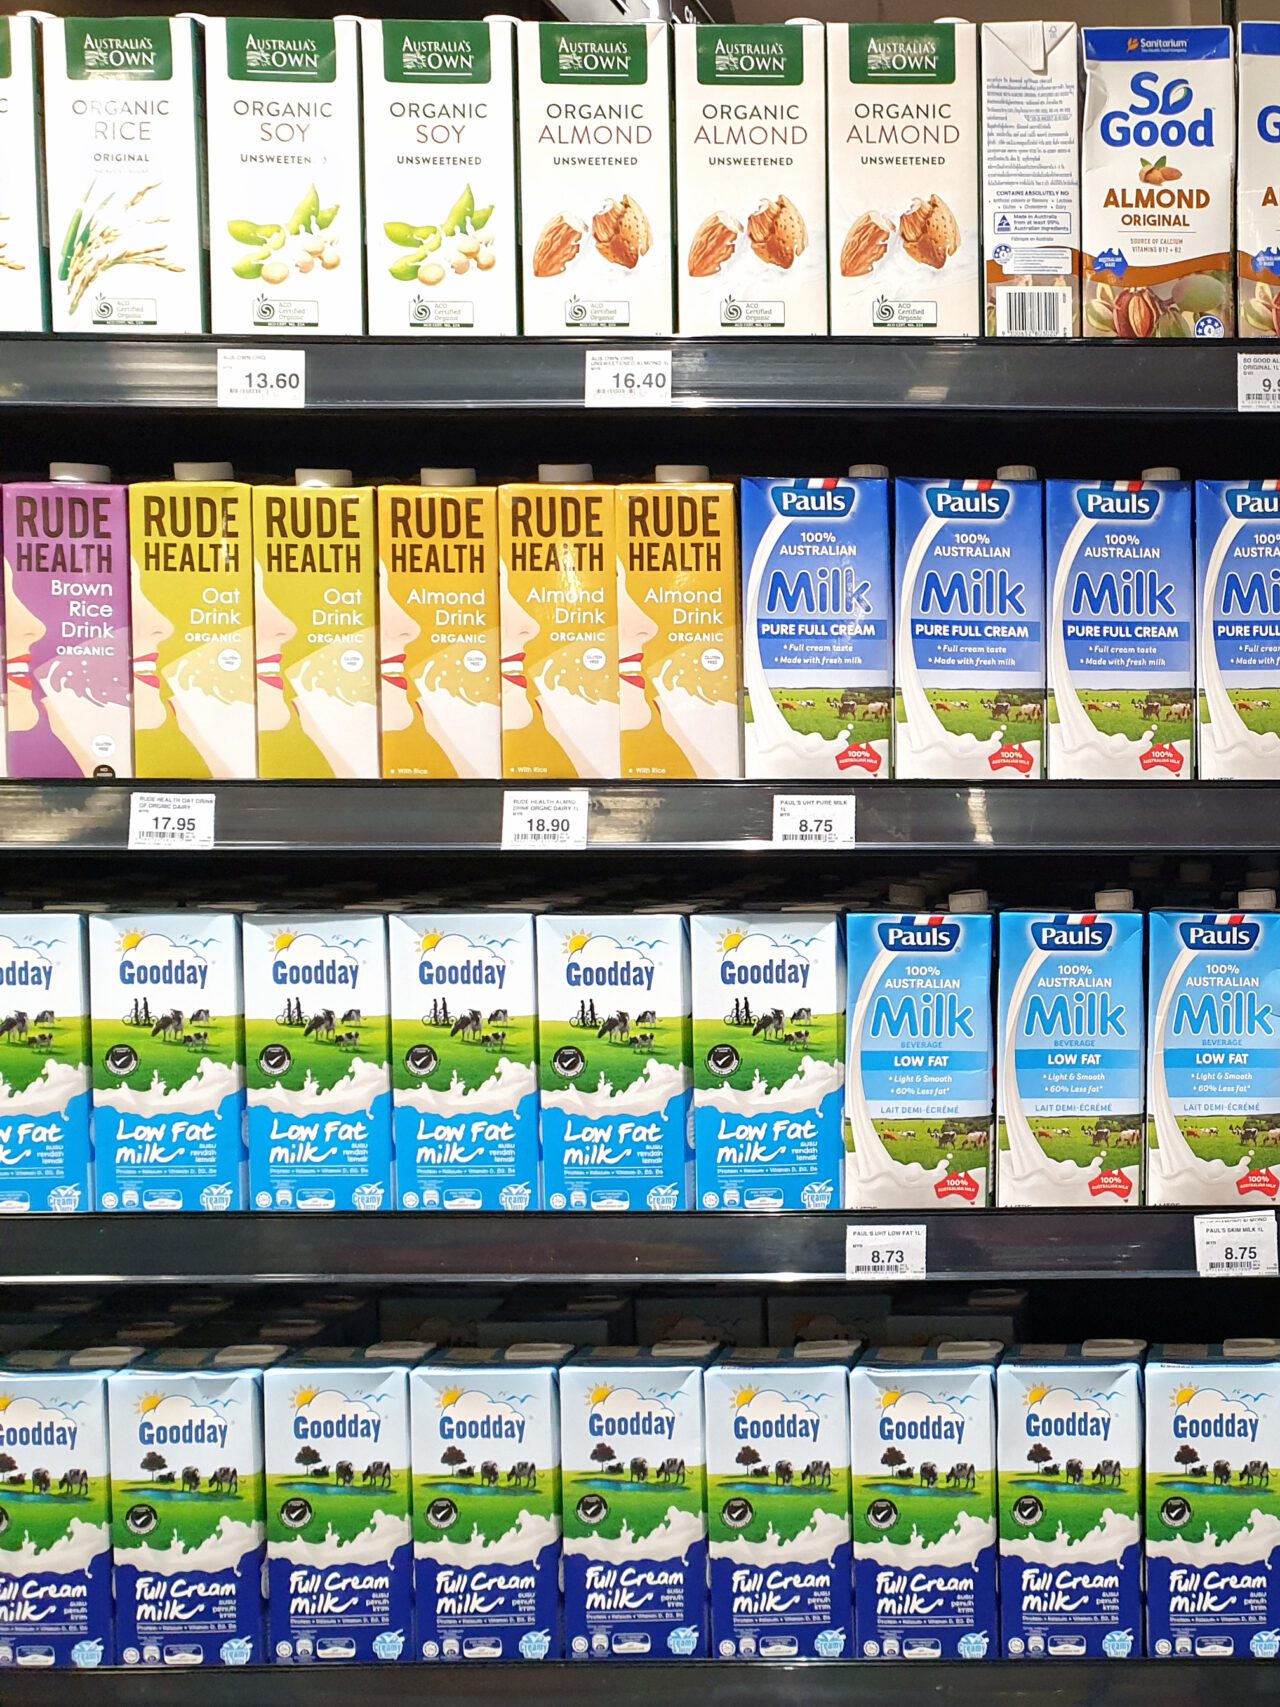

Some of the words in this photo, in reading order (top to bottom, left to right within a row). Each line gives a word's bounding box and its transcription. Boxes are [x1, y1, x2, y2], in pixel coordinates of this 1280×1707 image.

[868, 38, 935, 53] AUSTRALIA'S
[1141, 38, 1186, 48] Sanitarium
[892, 54, 937, 70] OWN
[1129, 72, 1193, 116] So
[390, 102, 487, 118] ORGANIC
[855, 103, 951, 119] ORGANIC
[95, 121, 151, 141] RICE
[416, 125, 465, 144] SOY
[846, 125, 960, 144] ALMOND
[1100, 108, 1214, 147] Good
[94, 153, 149, 162] ORIGINAL
[397, 156, 482, 165] UNSWEETENED
[861, 156, 945, 165] UNSWEETENED
[1103, 188, 1210, 208] ALMOND
[1122, 214, 1190, 226] ORIGINAL
[245, 372, 299, 389] 13.60
[612, 372, 666, 388] 16.40
[16, 496, 112, 539] RUDE
[16, 543, 112, 573] HEALTH
[51, 580, 112, 597] Brown
[202, 588, 241, 604] Oat
[644, 587, 721, 604] Almond
[69, 601, 113, 617] Rice
[190, 608, 241, 626] Drink
[673, 608, 724, 625] Drink
[62, 622, 114, 638] Drink
[1218, 626, 1250, 637] PURE
[1253, 625, 1280, 636] FULL
[56, 646, 114, 656] ORGANIC
[518, 766, 534, 774] With
[535, 766, 548, 774] Rice
[152, 817, 196, 831] 17.95
[527, 819, 570, 832] 18.90
[799, 819, 833, 832] 8.75
[888, 928, 950, 946] Pauls
[119, 959, 208, 989] Goodday
[870, 993, 974, 1039] Milk
[894, 1056, 924, 1067] LOW
[928, 1056, 949, 1066] FAT
[894, 1075, 914, 1083] Light
[923, 1075, 952, 1083] Smooth
[902, 1105, 959, 1113] DEMI-ÉCRÉMÉ
[116, 1119, 167, 1142] Low
[171, 1120, 217, 1142] Fat
[116, 1142, 186, 1164] milk
[871, 1250, 904, 1263] 8.73
[1224, 1247, 1257, 1260] 8.75
[1173, 1413, 1259, 1442] Goodday
[289, 1570, 321, 1594] Full
[324, 1571, 389, 1591] Cream
[290, 1592, 358, 1615] milk
